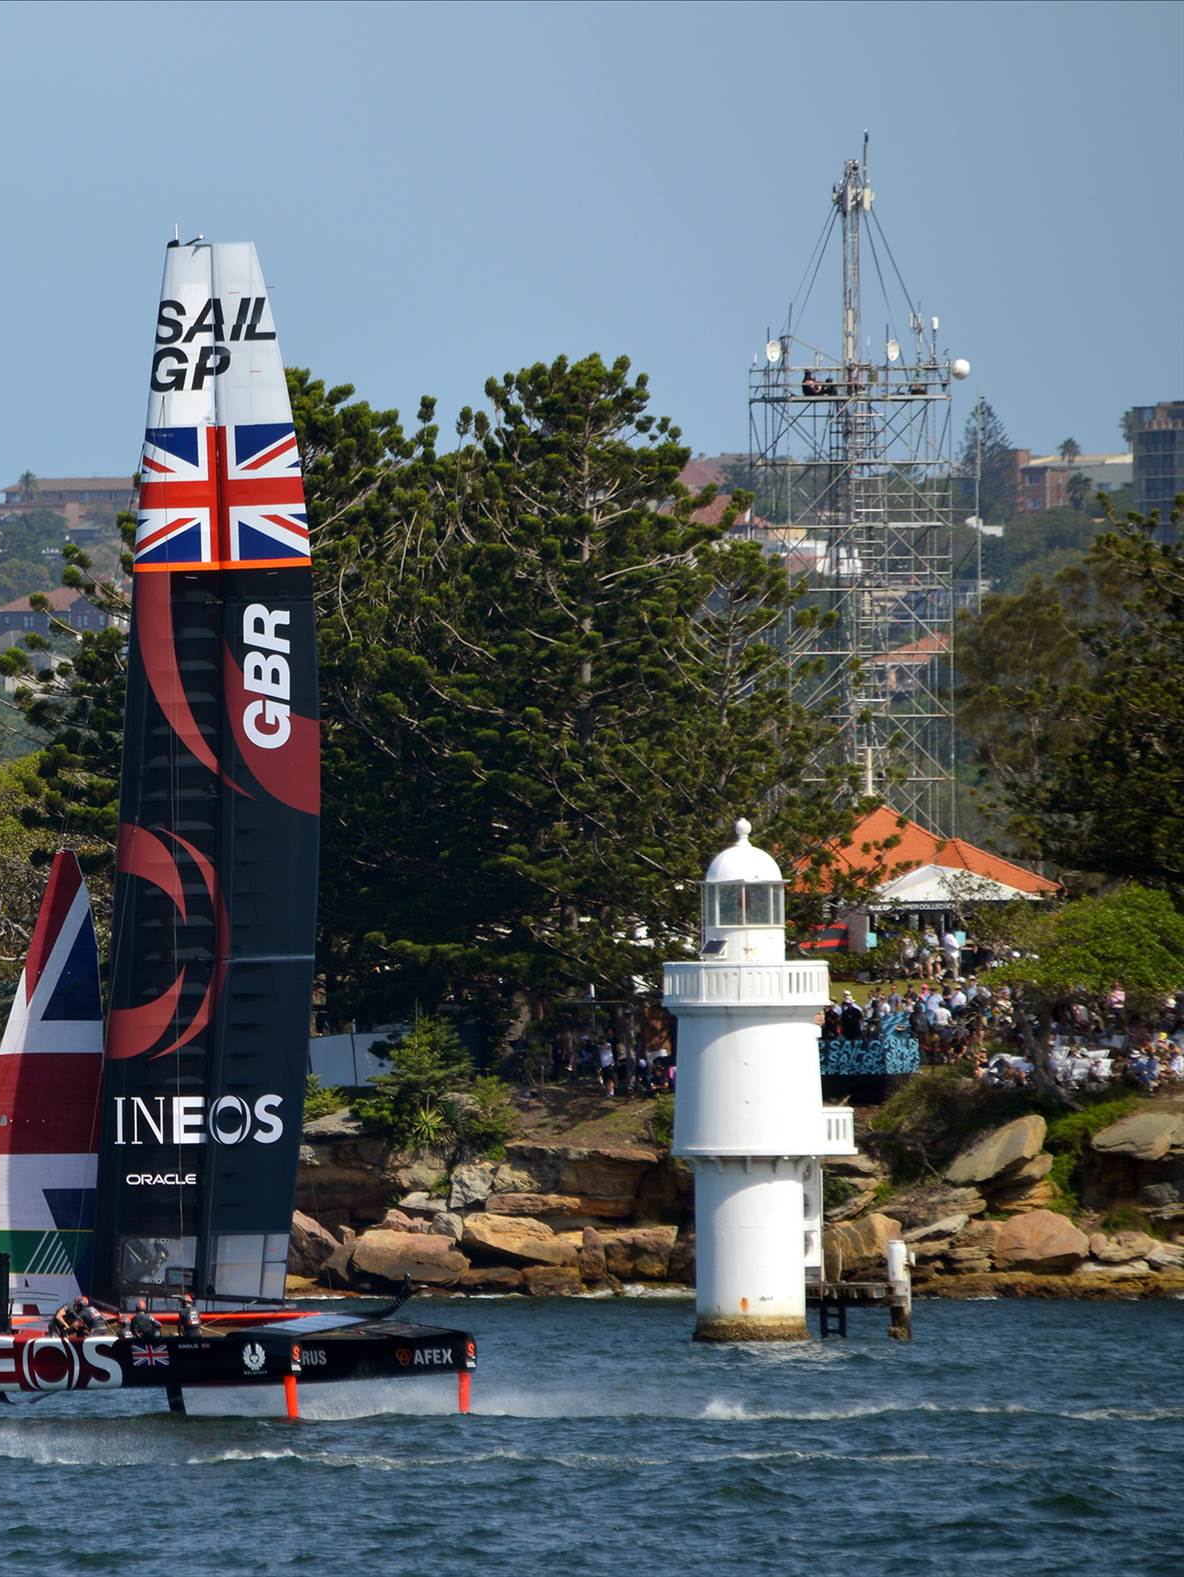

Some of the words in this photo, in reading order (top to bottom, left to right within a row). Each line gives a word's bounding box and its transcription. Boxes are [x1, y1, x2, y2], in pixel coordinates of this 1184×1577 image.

[155, 296, 276, 345] SAIL
[150, 346, 231, 393] GP
[243, 603, 291, 749] GBR
[114, 1094, 284, 1145] INEOS
[125, 1173, 197, 1186] ORACLE
[414, 1348, 453, 1364] AFEX
